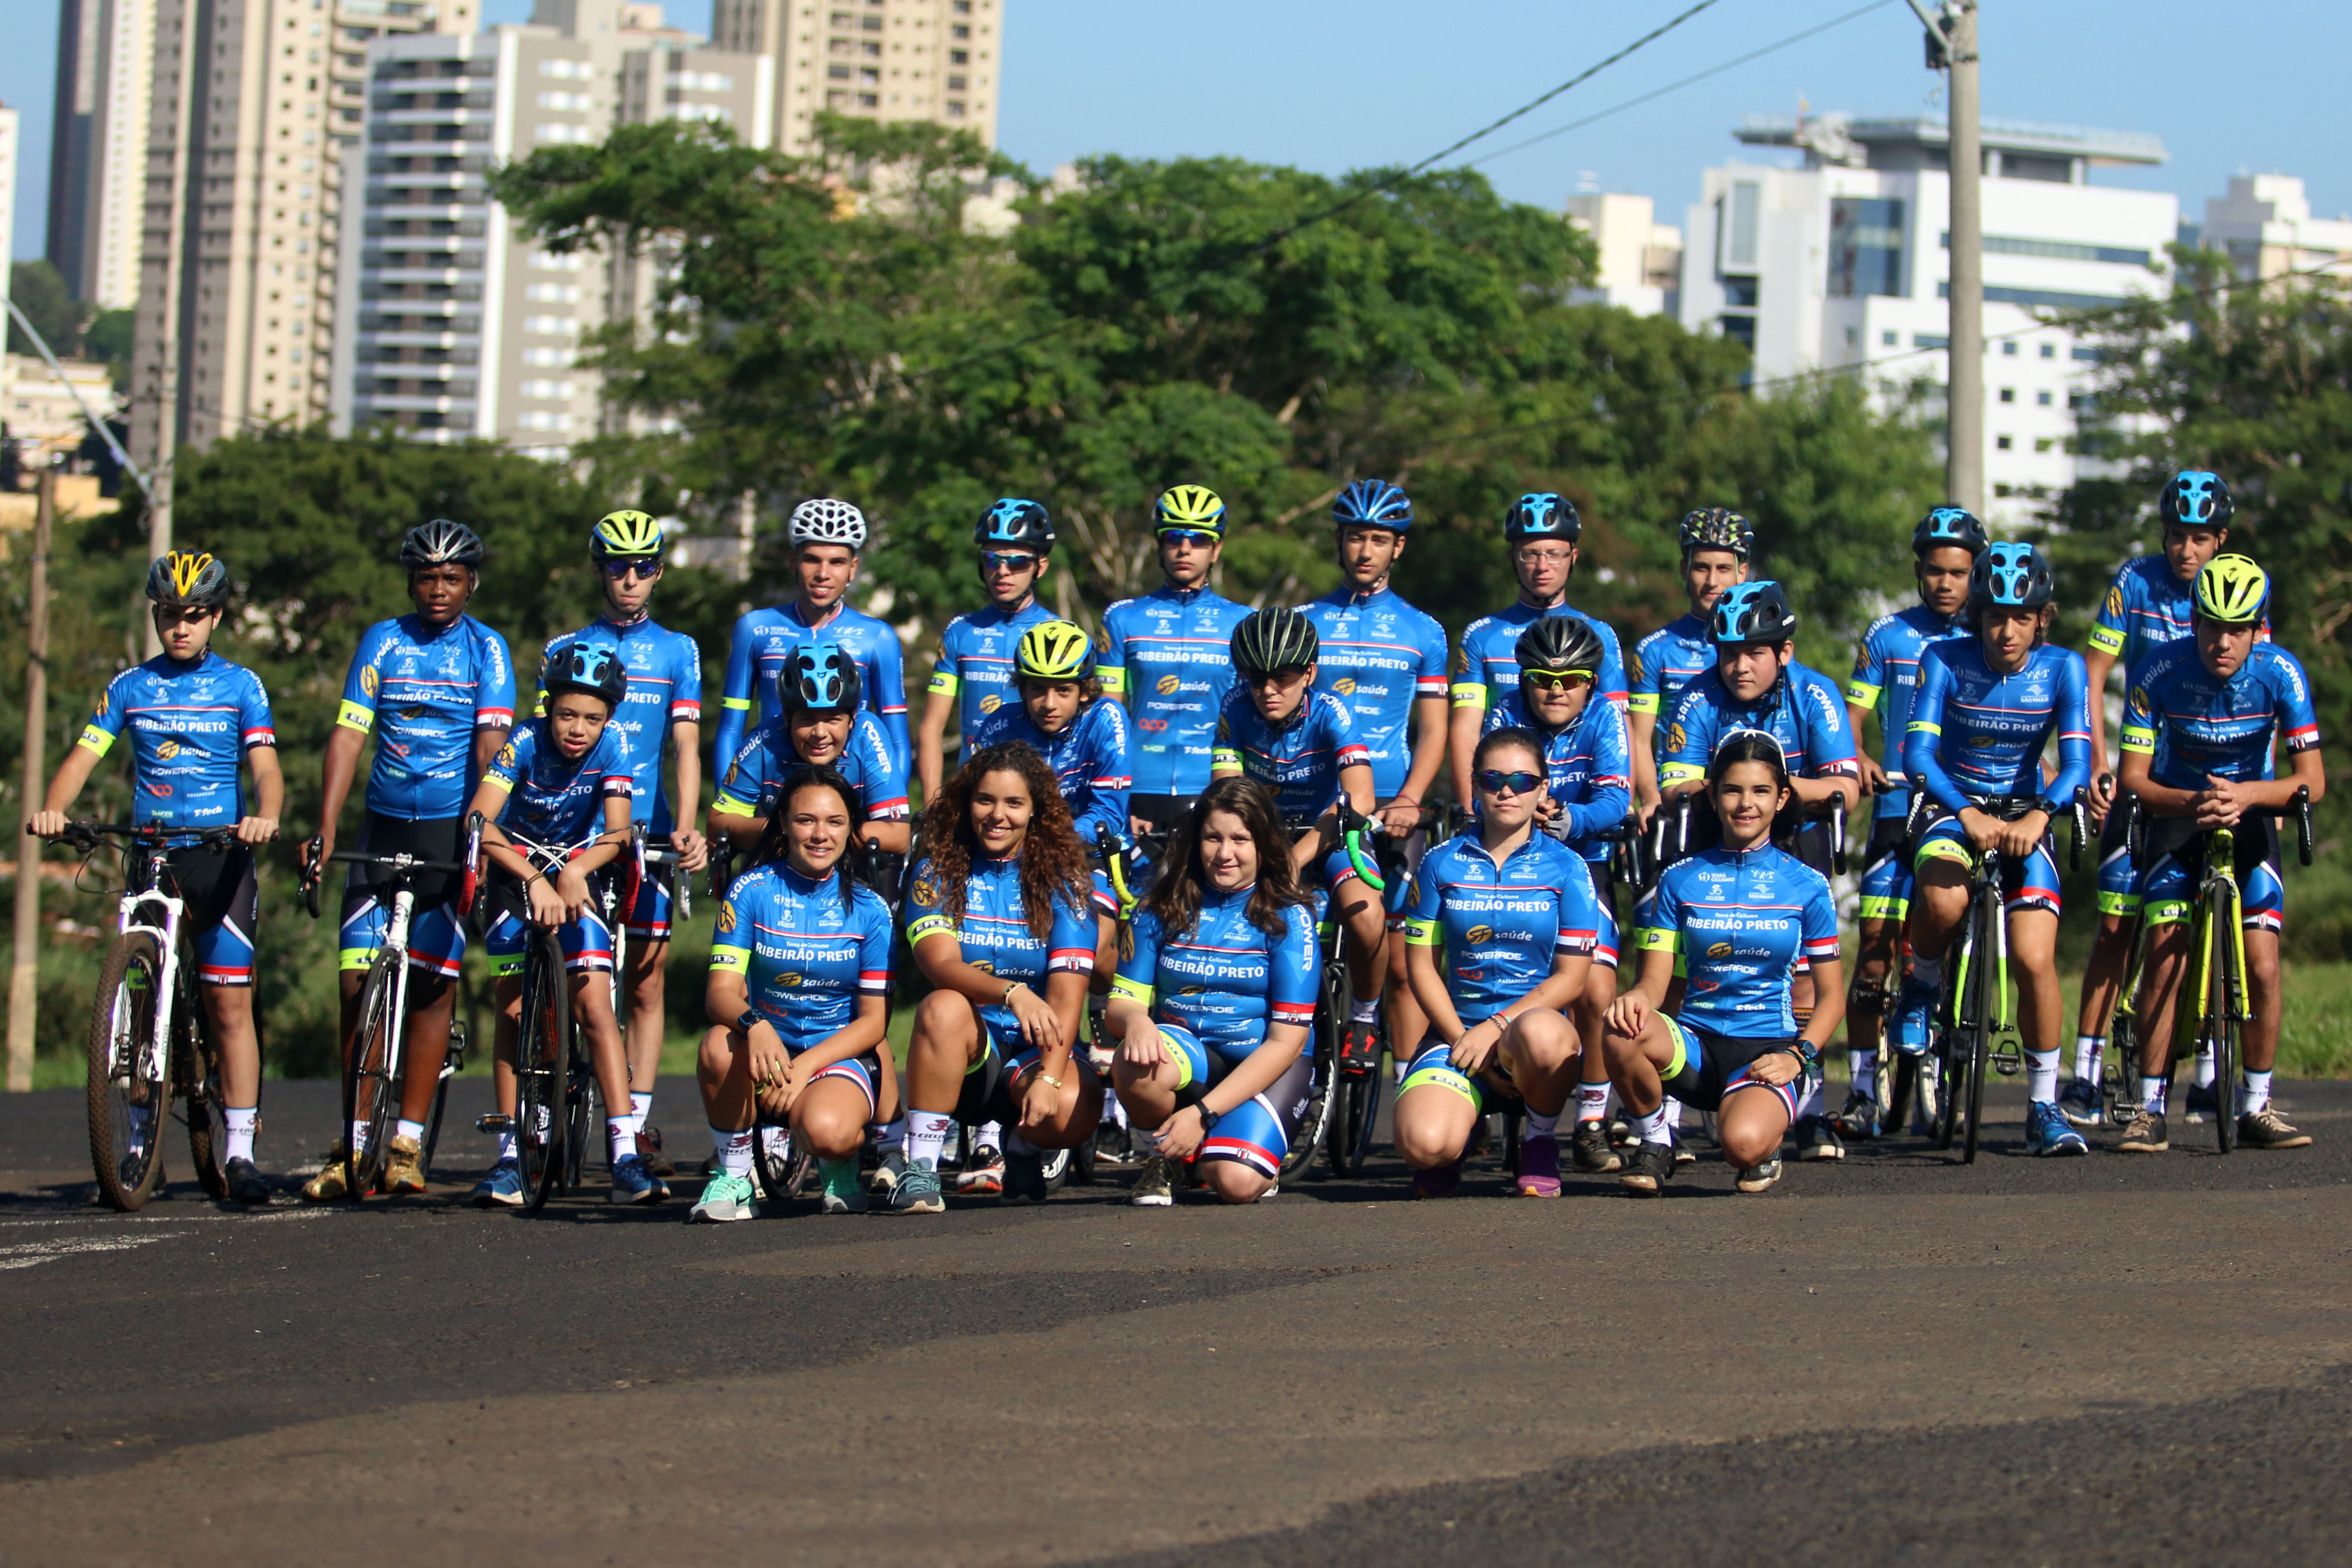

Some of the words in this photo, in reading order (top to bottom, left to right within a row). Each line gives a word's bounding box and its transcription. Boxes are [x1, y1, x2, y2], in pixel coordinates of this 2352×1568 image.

[1462, 617, 1491, 645] saúde
[1865, 614, 1895, 643] saúde
[1636, 628, 1667, 654] saúde
[374, 637, 399, 668] saúde
[1136, 651, 1189, 662] RIBEIRÃO
[1192, 653, 1229, 665] PRETO
[485, 636, 505, 685] POWER
[1370, 659, 1409, 671] PRETO
[1494, 673, 1519, 683] RIBE
[2141, 658, 2172, 689] saúde
[2272, 654, 2306, 702] POWER
[1179, 682, 1211, 692] saúde
[1357, 685, 1389, 695] saúde
[624, 692, 661, 704] PRETO
[1147, 701, 1202, 710] POWERADE
[1318, 693, 1351, 726] POWER
[1354, 706, 1380, 715] RADE
[1807, 683, 1840, 732] POWER
[135, 718, 186, 732] RIBEIRÃO
[188, 721, 227, 732] PRETO
[1948, 710, 2009, 730] RIBEIRÃO
[391, 726, 446, 738] POWERADE
[1607, 702, 1628, 756] POWER
[738, 729, 770, 762] saúde
[862, 720, 892, 774] POWER
[2125, 735, 2147, 746] ERT
[1185, 746, 1211, 754] T-Tech
[1248, 761, 1286, 782] BEIRÃO
[1289, 763, 1326, 781] PRETO
[730, 872, 764, 900] saúde
[1446, 898, 1504, 911] RIBEIRÃO
[1507, 901, 1550, 912] PRETO
[1687, 917, 1743, 930] RIBEIRÃO
[1746, 920, 1788, 930] PRETO
[997, 927, 1019, 935] Ciclismo
[1292, 904, 1313, 971] POWER
[1494, 931, 1533, 941] saúde
[956, 931, 1003, 946] BEIRÃO
[1007, 937, 1047, 950] PRET
[756, 941, 814, 962] RIBEIRÃO
[818, 948, 856, 962] PRETO
[1462, 951, 1522, 961] POWERADE
[1734, 947, 1770, 957] saúde
[1160, 953, 1215, 976] RIBEIRÃO
[1218, 966, 1264, 978] PRETO
[1208, 956, 1231, 964] Ciclismo
[995, 968, 1035, 976] saúde
[1700, 964, 1758, 975] POWERADE
[802, 978, 840, 988] saúde
[765, 988, 828, 1001] POWERADE
[1165, 998, 1234, 1014] POWERADE
[1692, 1000, 1715, 1009] TANGER
